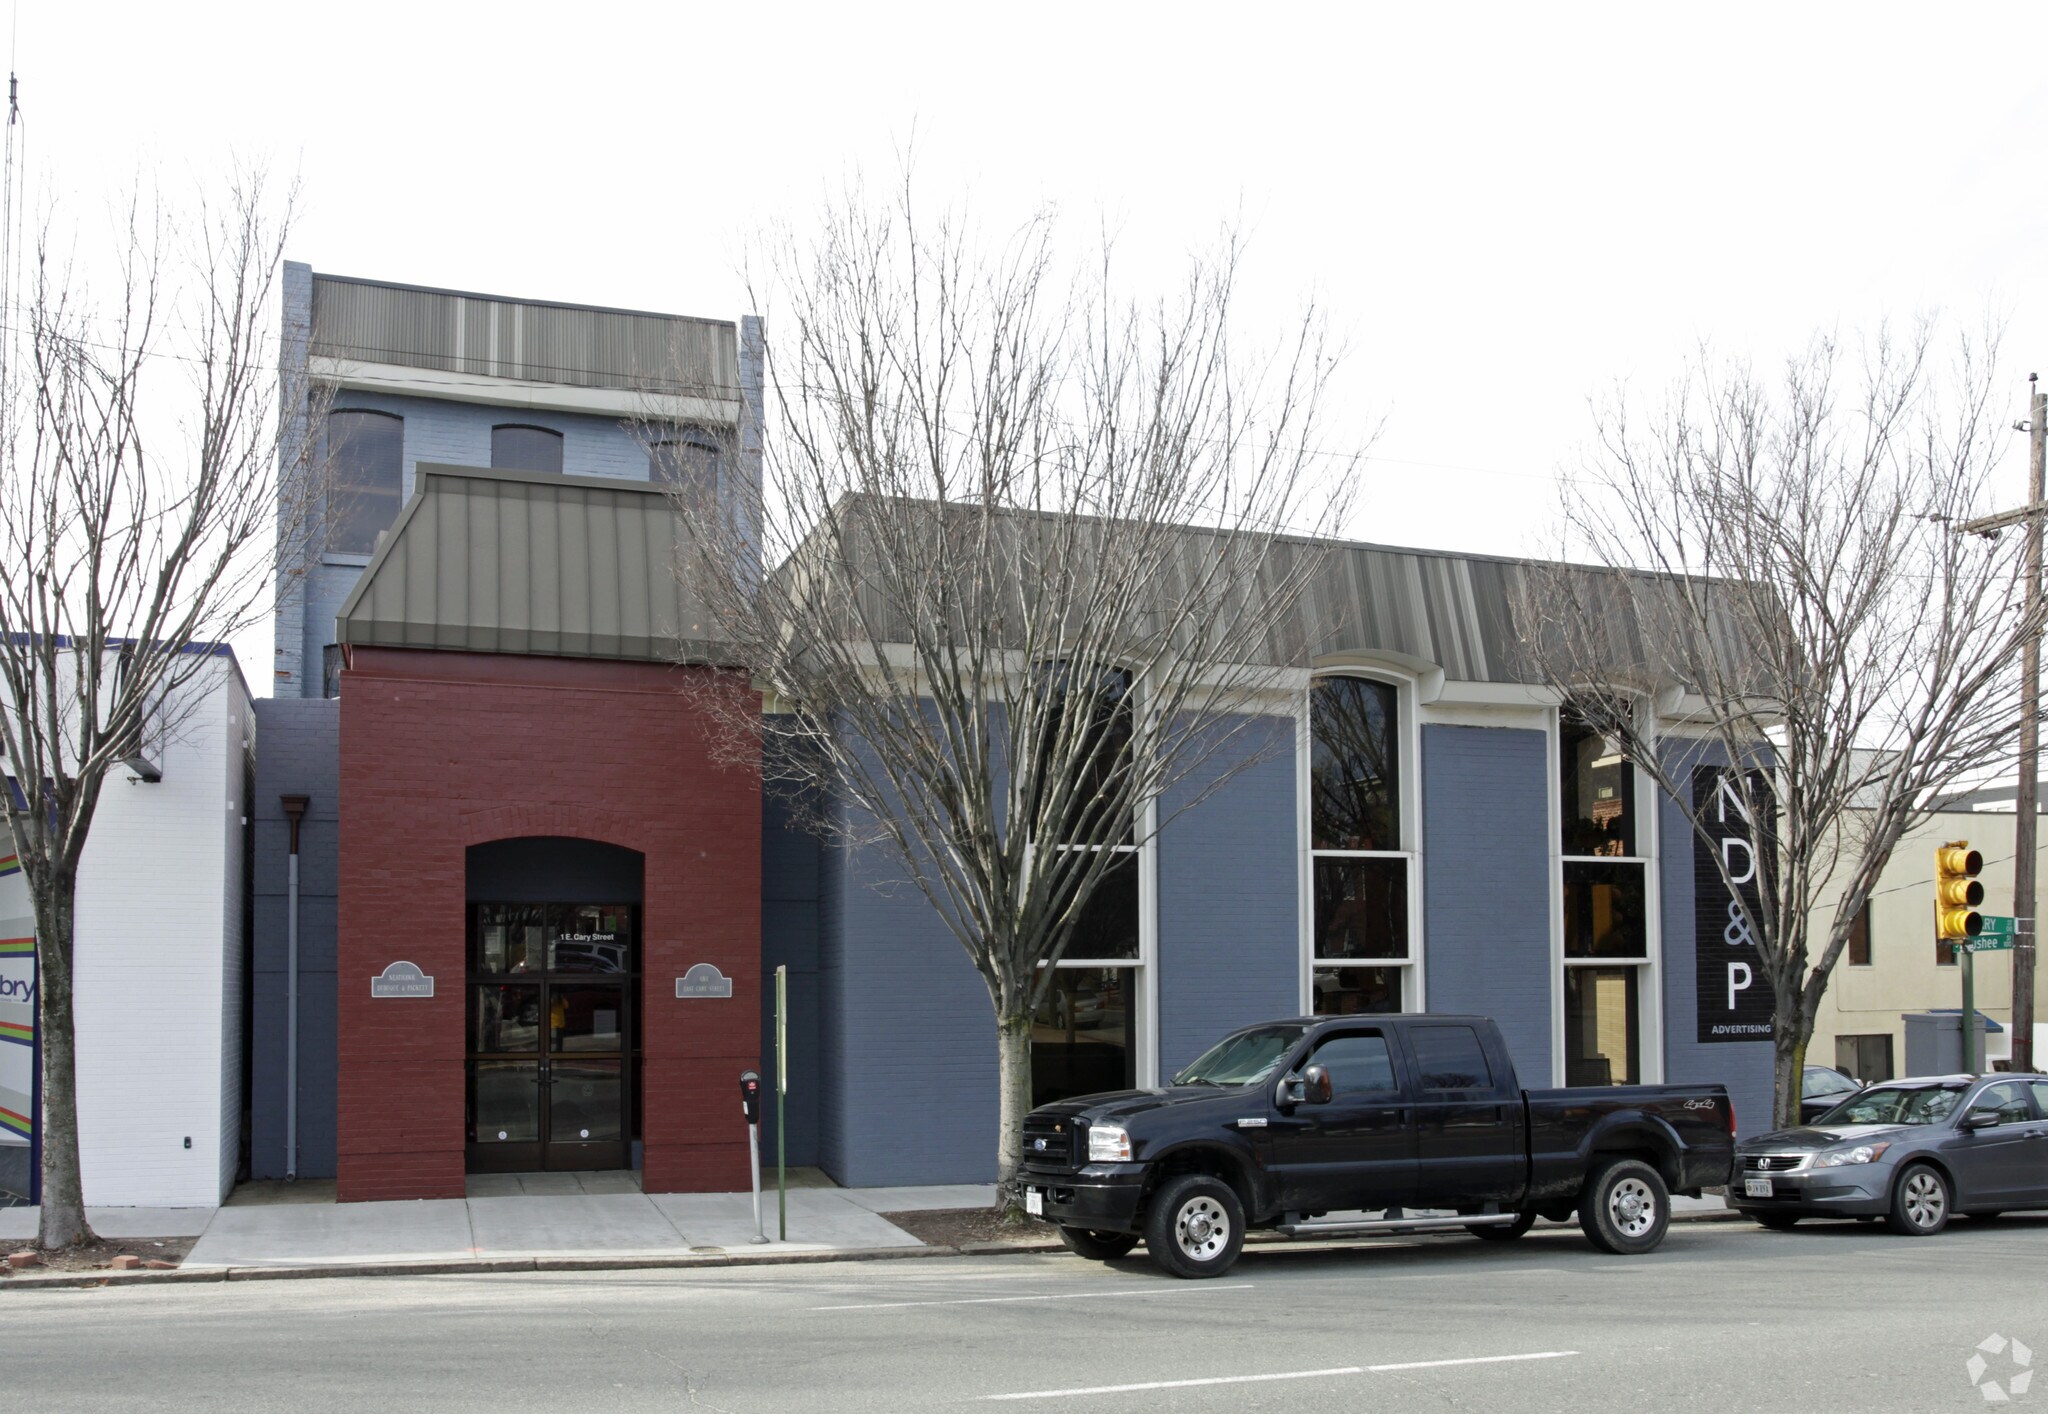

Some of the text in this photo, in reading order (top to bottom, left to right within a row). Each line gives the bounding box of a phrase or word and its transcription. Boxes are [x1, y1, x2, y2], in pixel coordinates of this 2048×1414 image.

[1982, 918, 1996, 931] RY
[560, 933, 614, 942] 1 E. Cary Street
[1711, 1024, 1772, 1035] ADVERTISING
